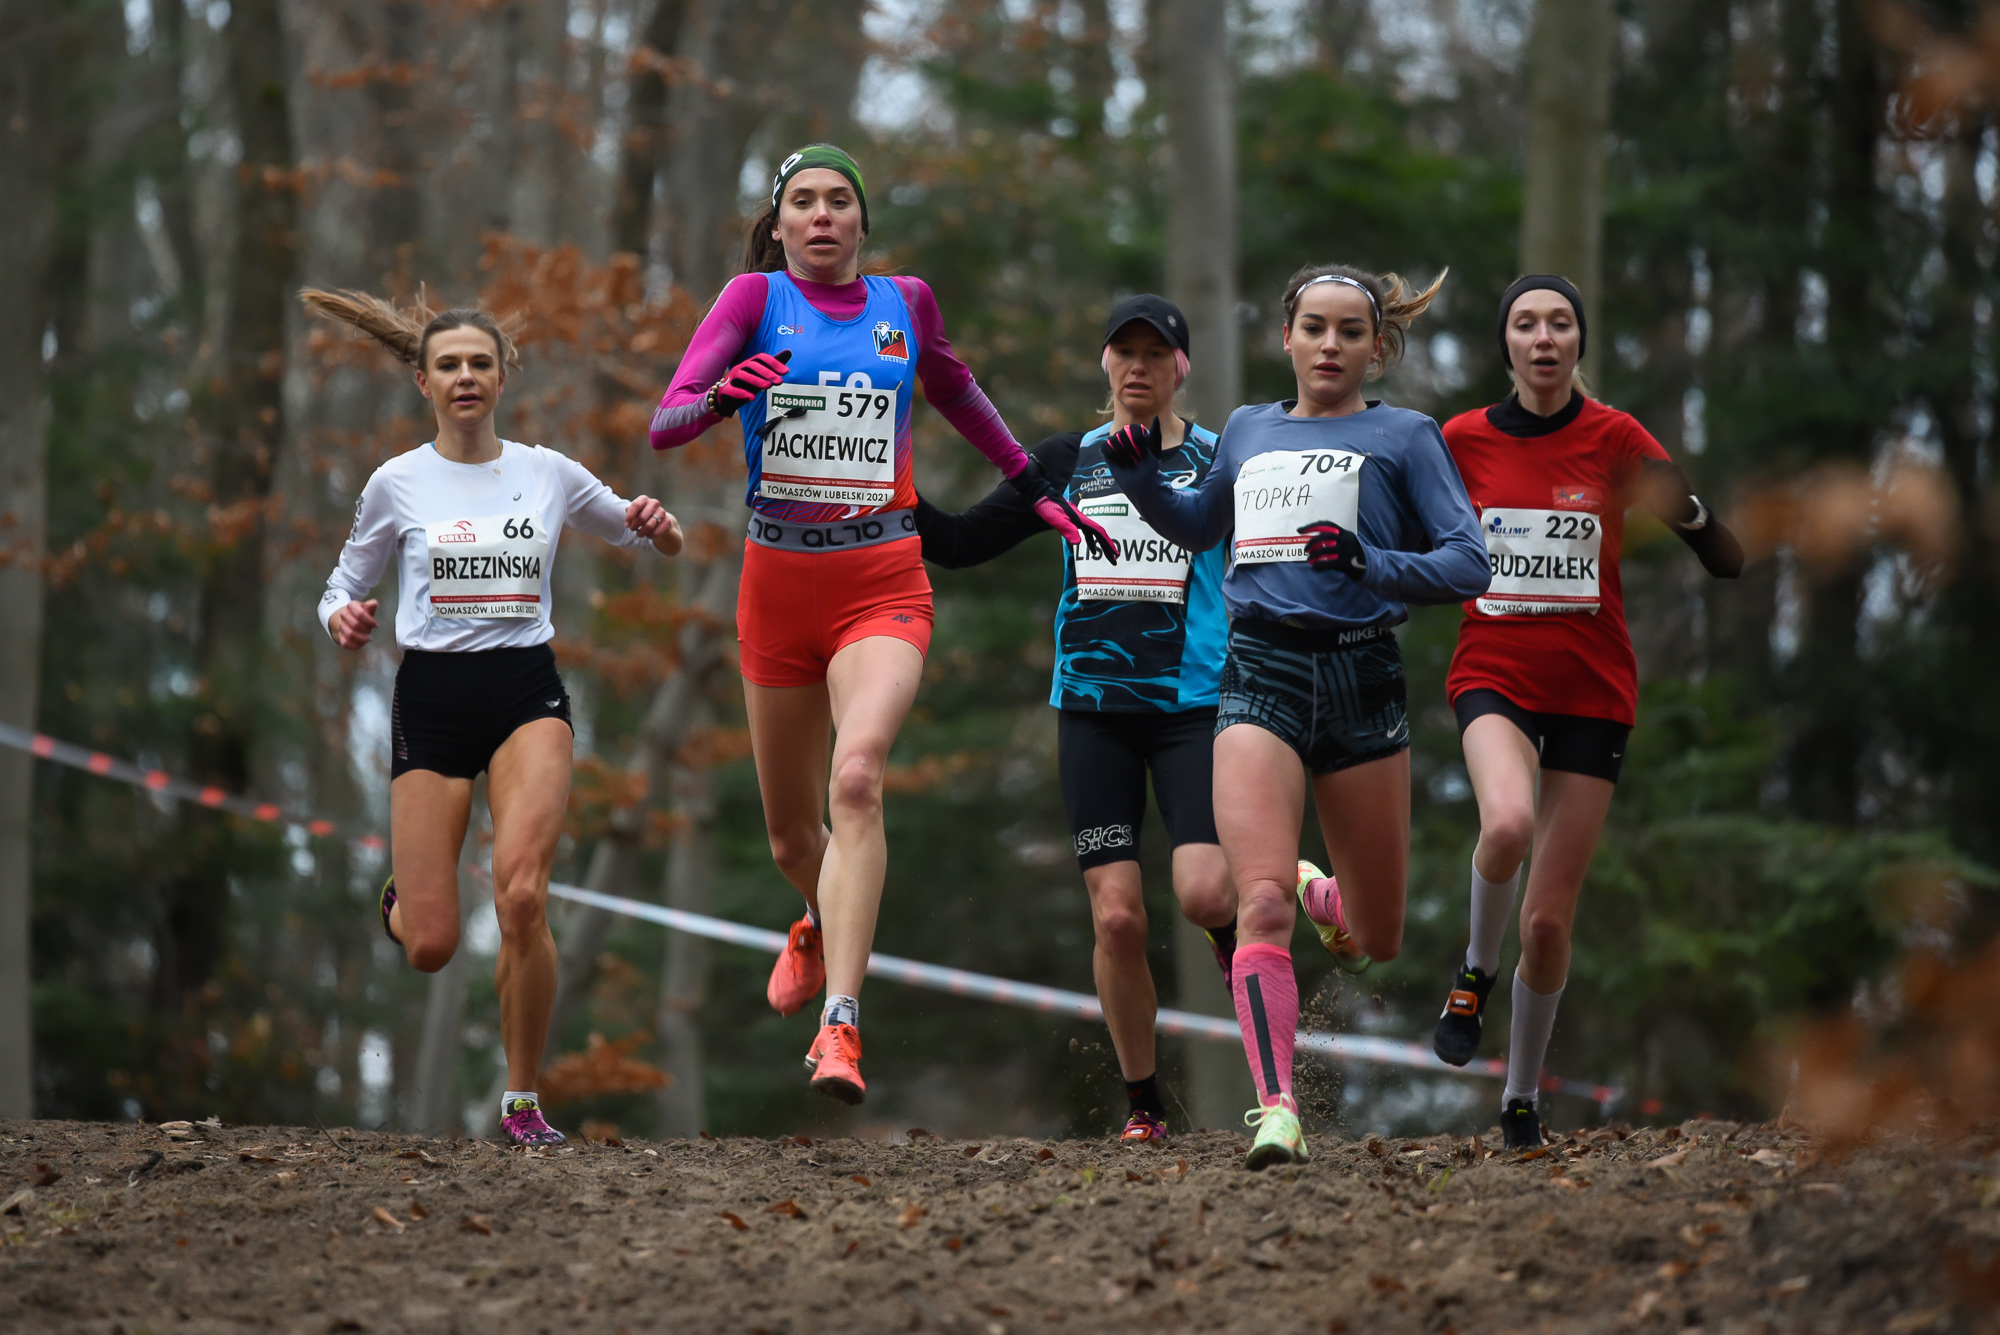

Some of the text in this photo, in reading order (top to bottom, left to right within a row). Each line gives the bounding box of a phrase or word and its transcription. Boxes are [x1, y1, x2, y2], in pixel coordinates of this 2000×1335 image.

[773, 396, 823, 408] BOGDANKA
[837, 393, 889, 419] 579
[767, 432, 888, 464] JACKIEWICZ
[1300, 454, 1353, 475] 704
[767, 485, 888, 502] TOMASZÓW LUBELSKI 2021
[1242, 483, 1313, 511] TOPKA
[1083, 505, 1127, 516] BOGDANKA
[503, 518, 534, 539] 66
[1495, 526, 1531, 535] OLIMP
[1545, 515, 1596, 540] 229
[439, 534, 475, 542] ORLEN
[1235, 547, 1309, 560] OMASZÓW LUBE
[433, 551, 540, 580] BRZEZIŃSKA
[1489, 554, 1596, 580] BUDZIŁEK
[1078, 587, 1125, 598] OMASZÓW
[1128, 589, 1166, 598] LUBELSKI
[435, 604, 538, 615] TOMASZÓW LUBELSKI 2021
[1483, 603, 1532, 613] TOMASZÓW
[891, 614, 915, 624] 4F
[1338, 625, 1376, 645] NIKE
